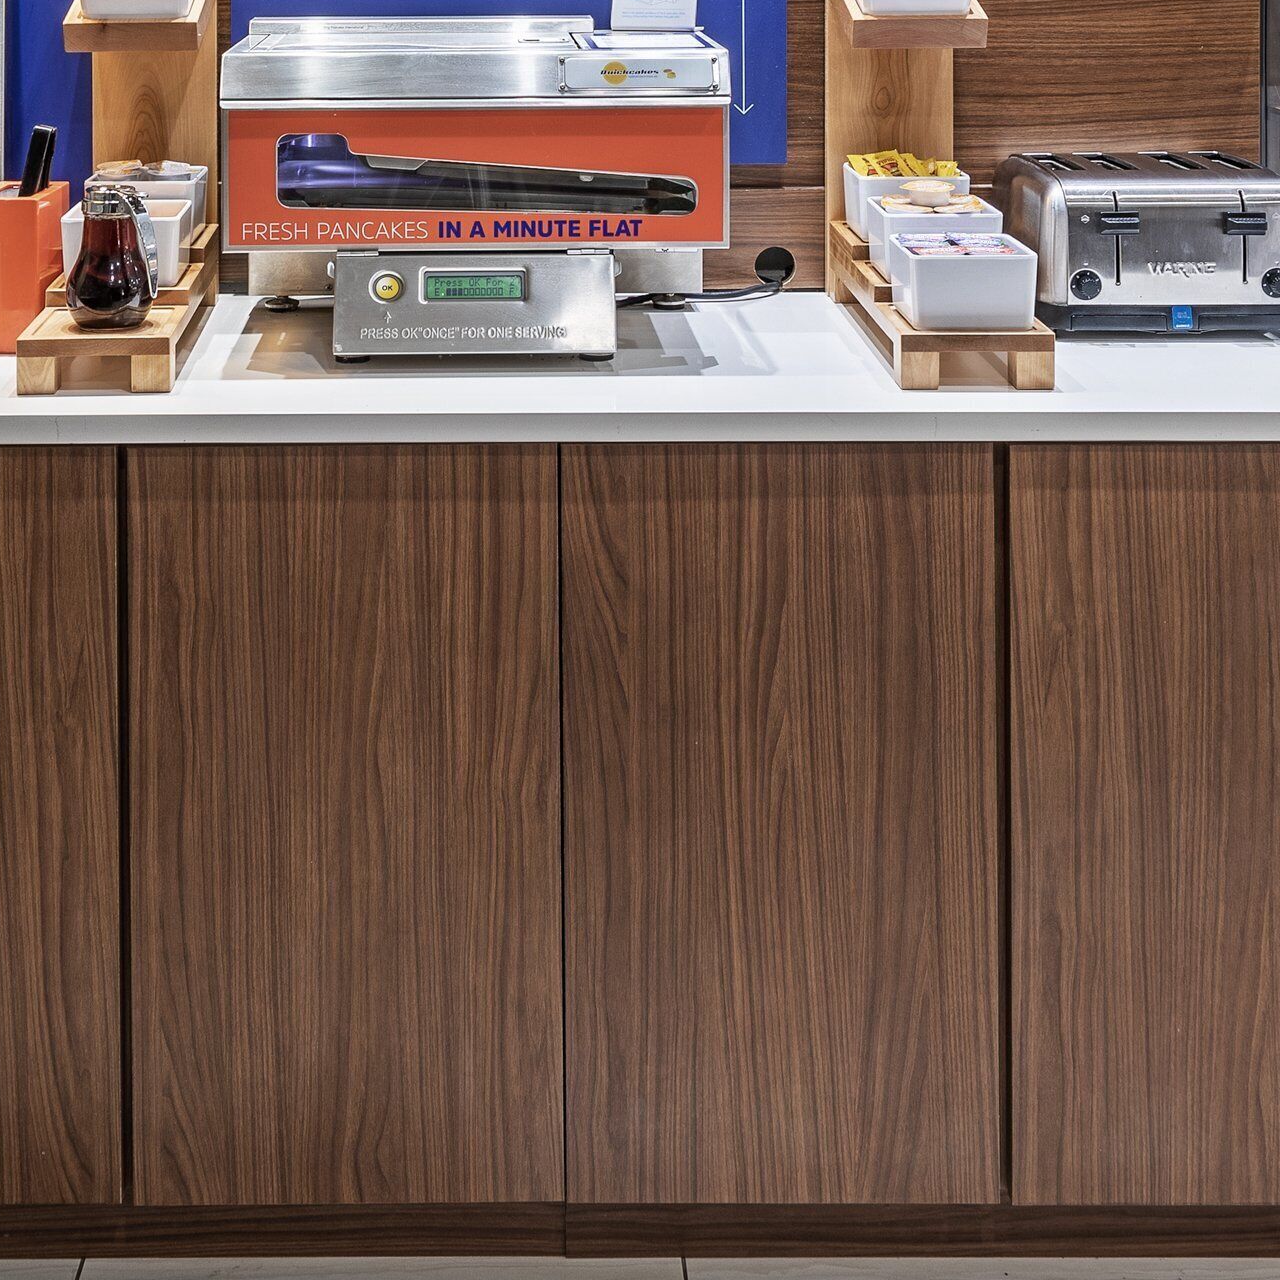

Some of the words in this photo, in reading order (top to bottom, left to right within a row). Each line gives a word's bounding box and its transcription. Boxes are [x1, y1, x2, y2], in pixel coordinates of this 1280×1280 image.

[241, 221, 308, 241] FRESH
[317, 221, 428, 240] PANCAKES
[438, 220, 462, 239] IN
[469, 220, 486, 238] A
[493, 219, 581, 238] MINUTE
[588, 218, 644, 238] FLAT
[434, 278, 463, 287] Press
[468, 278, 480, 287] OK
[360, 327, 399, 340] PRESS
[461, 327, 485, 339] FOR
[487, 327, 513, 339] ONE
[514, 325, 568, 340] SERVING
